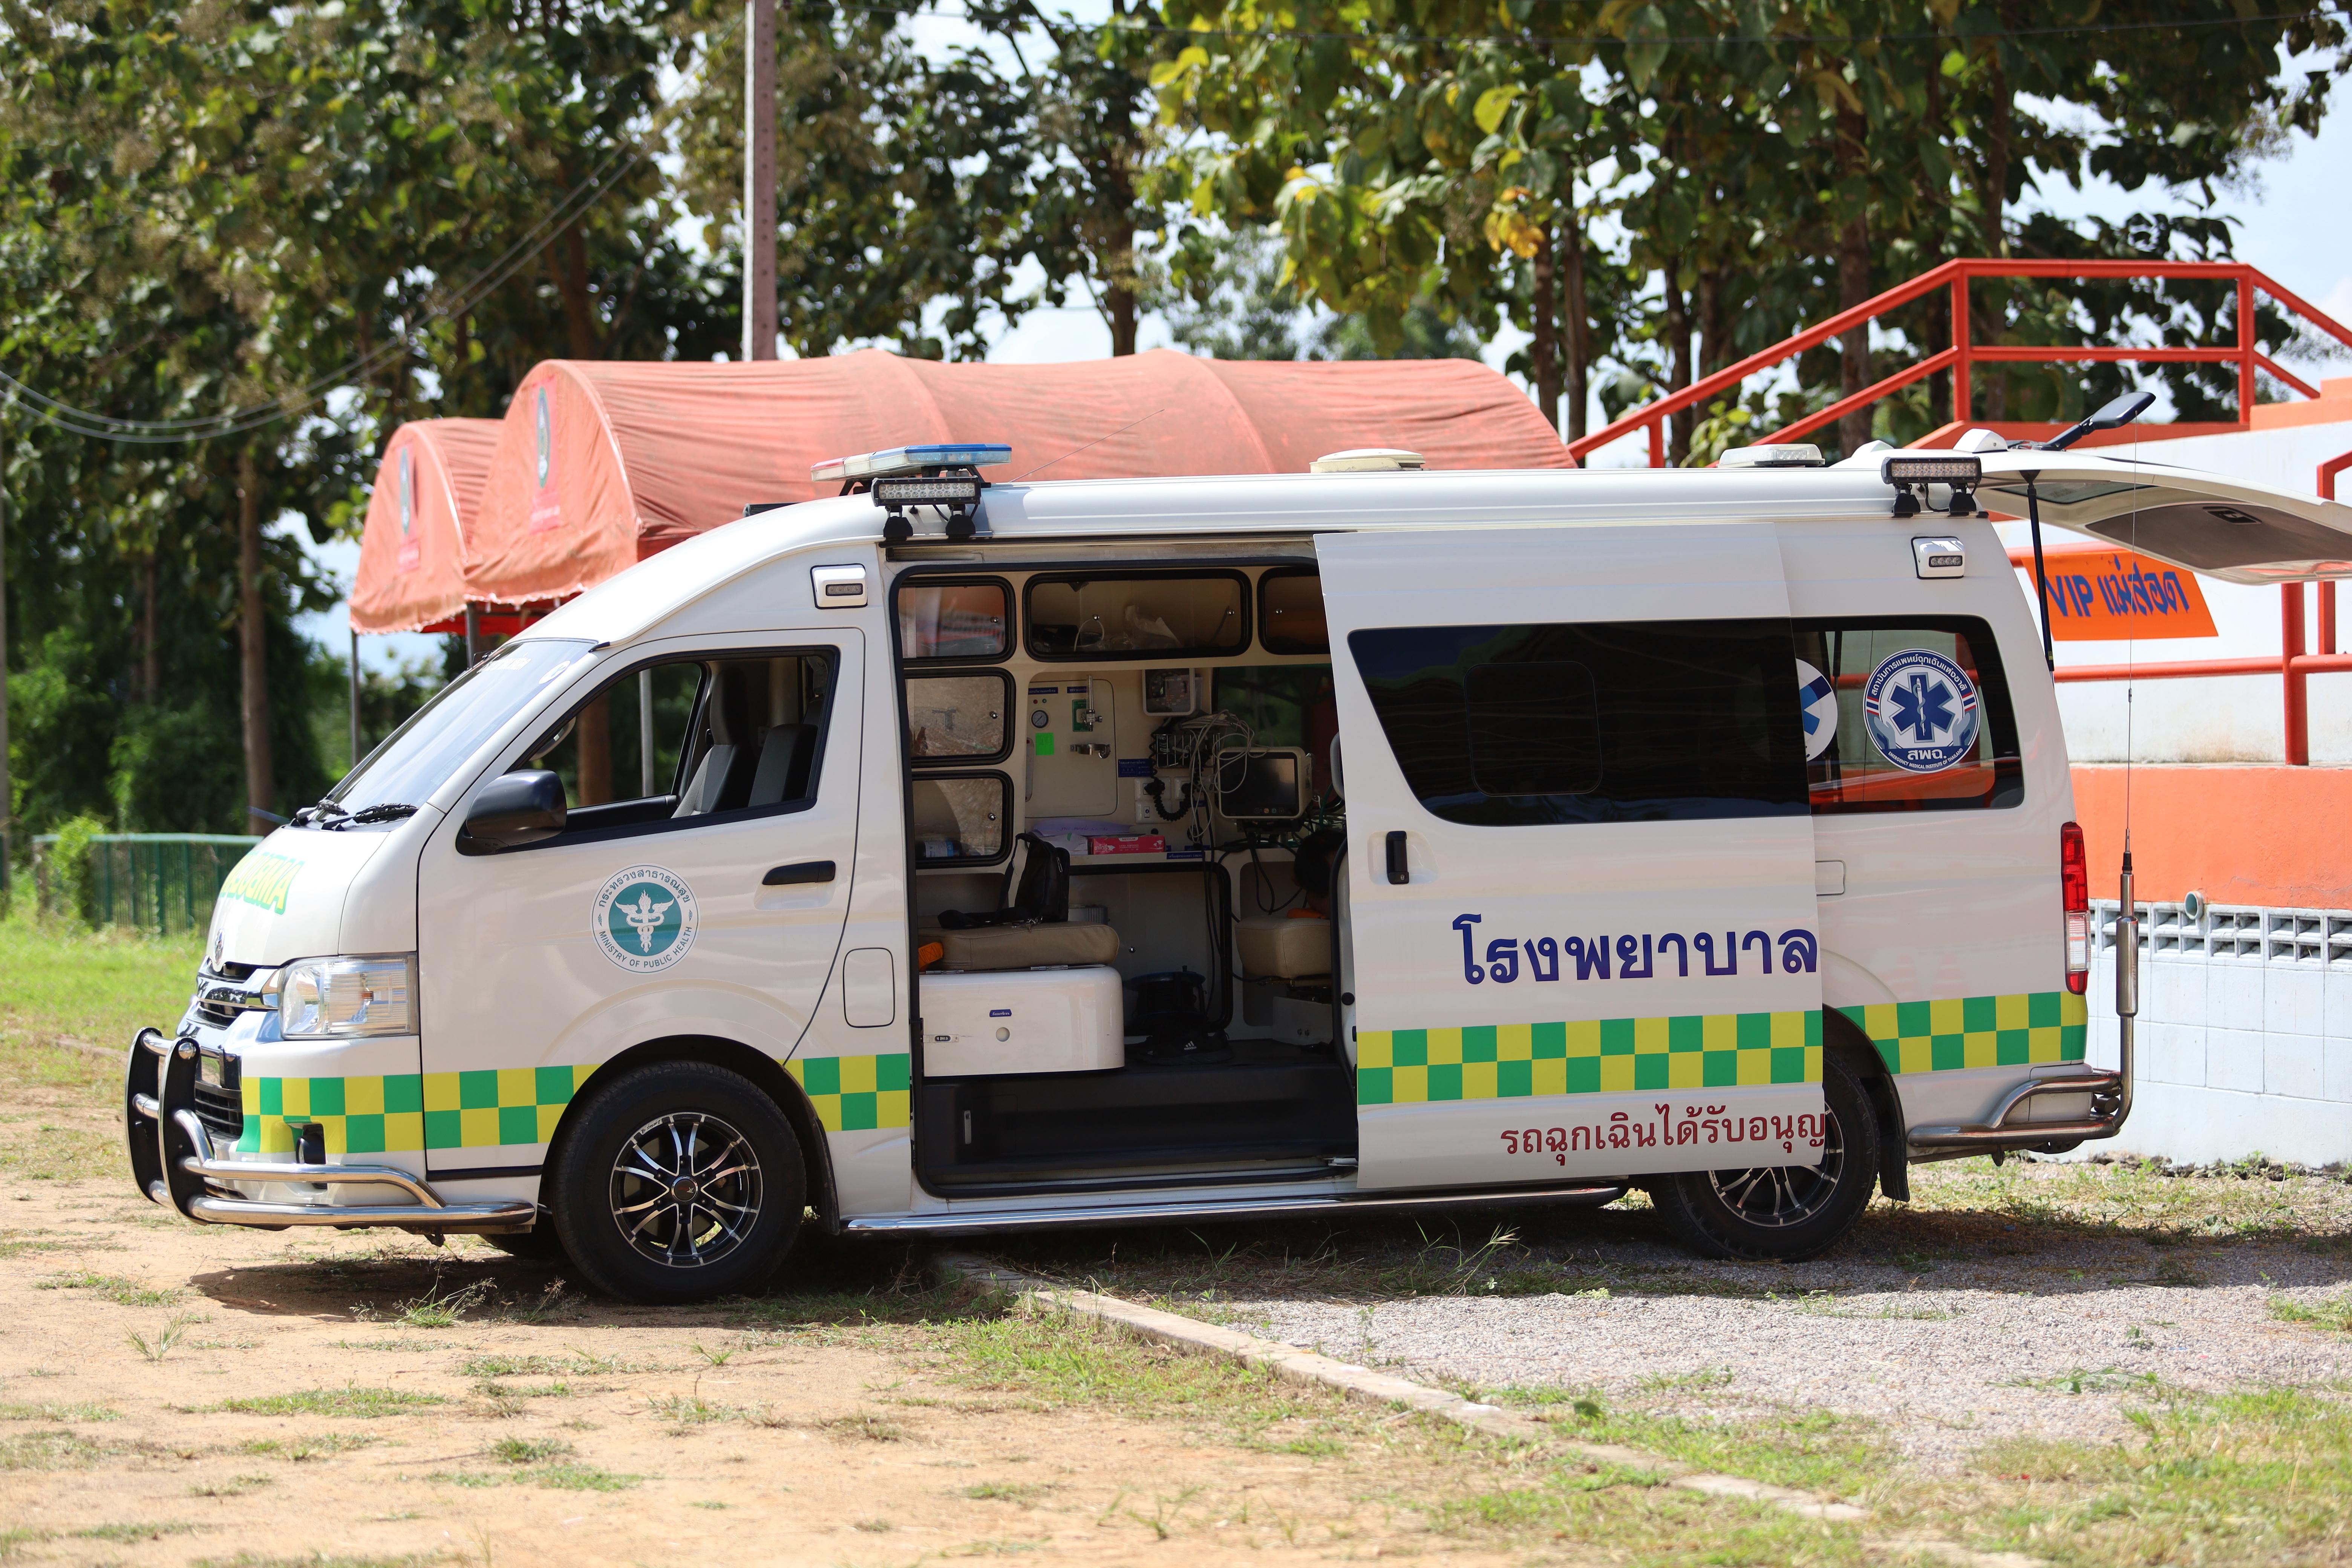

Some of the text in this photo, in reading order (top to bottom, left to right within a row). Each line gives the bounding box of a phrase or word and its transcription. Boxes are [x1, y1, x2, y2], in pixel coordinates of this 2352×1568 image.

[2045, 575, 2094, 617] VIP
[2097, 555, 2189, 616] แม่สอด
[1871, 654, 1968, 696] สถาบันการแพทย์ฉุกเฉินแห่งชาติ
[1888, 751, 1909, 766] EMERGENCY
[1948, 748, 1963, 762] THAILAND
[1907, 749, 1947, 760] สพฉ.
[599, 869, 691, 907] กระทรวงสาธารณสุข
[599, 926, 692, 968] MINISTRY OF PUBLIC HEALTH
[1452, 914, 1817, 985] โรงพยาบาล
[1500, 1104, 1824, 1165] รถฉุกเฉินได้รับอนุญ
